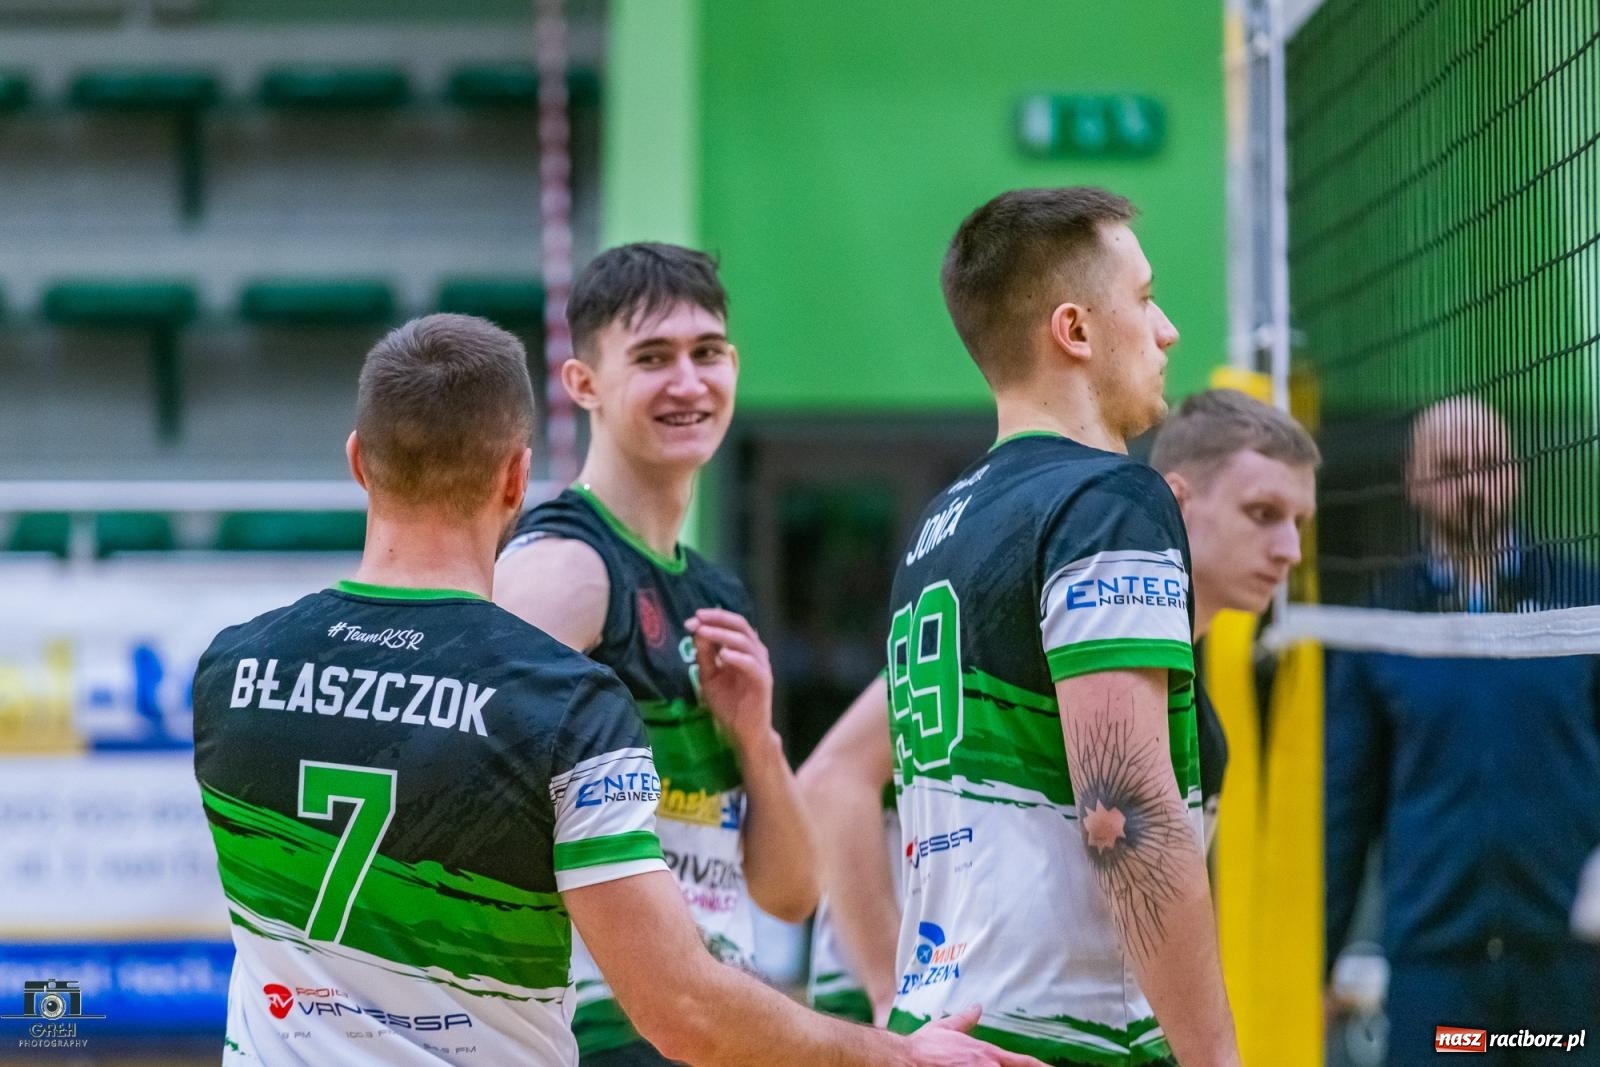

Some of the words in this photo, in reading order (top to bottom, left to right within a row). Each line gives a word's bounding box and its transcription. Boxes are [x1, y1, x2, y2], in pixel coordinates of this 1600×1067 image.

[1066, 576, 1181, 610] ENTEC
[327, 621, 424, 651] #TeamKSR
[229, 657, 497, 738] BŁASZCZOK
[297, 759, 398, 944] 7
[298, 1000, 472, 1031] VANESSA
